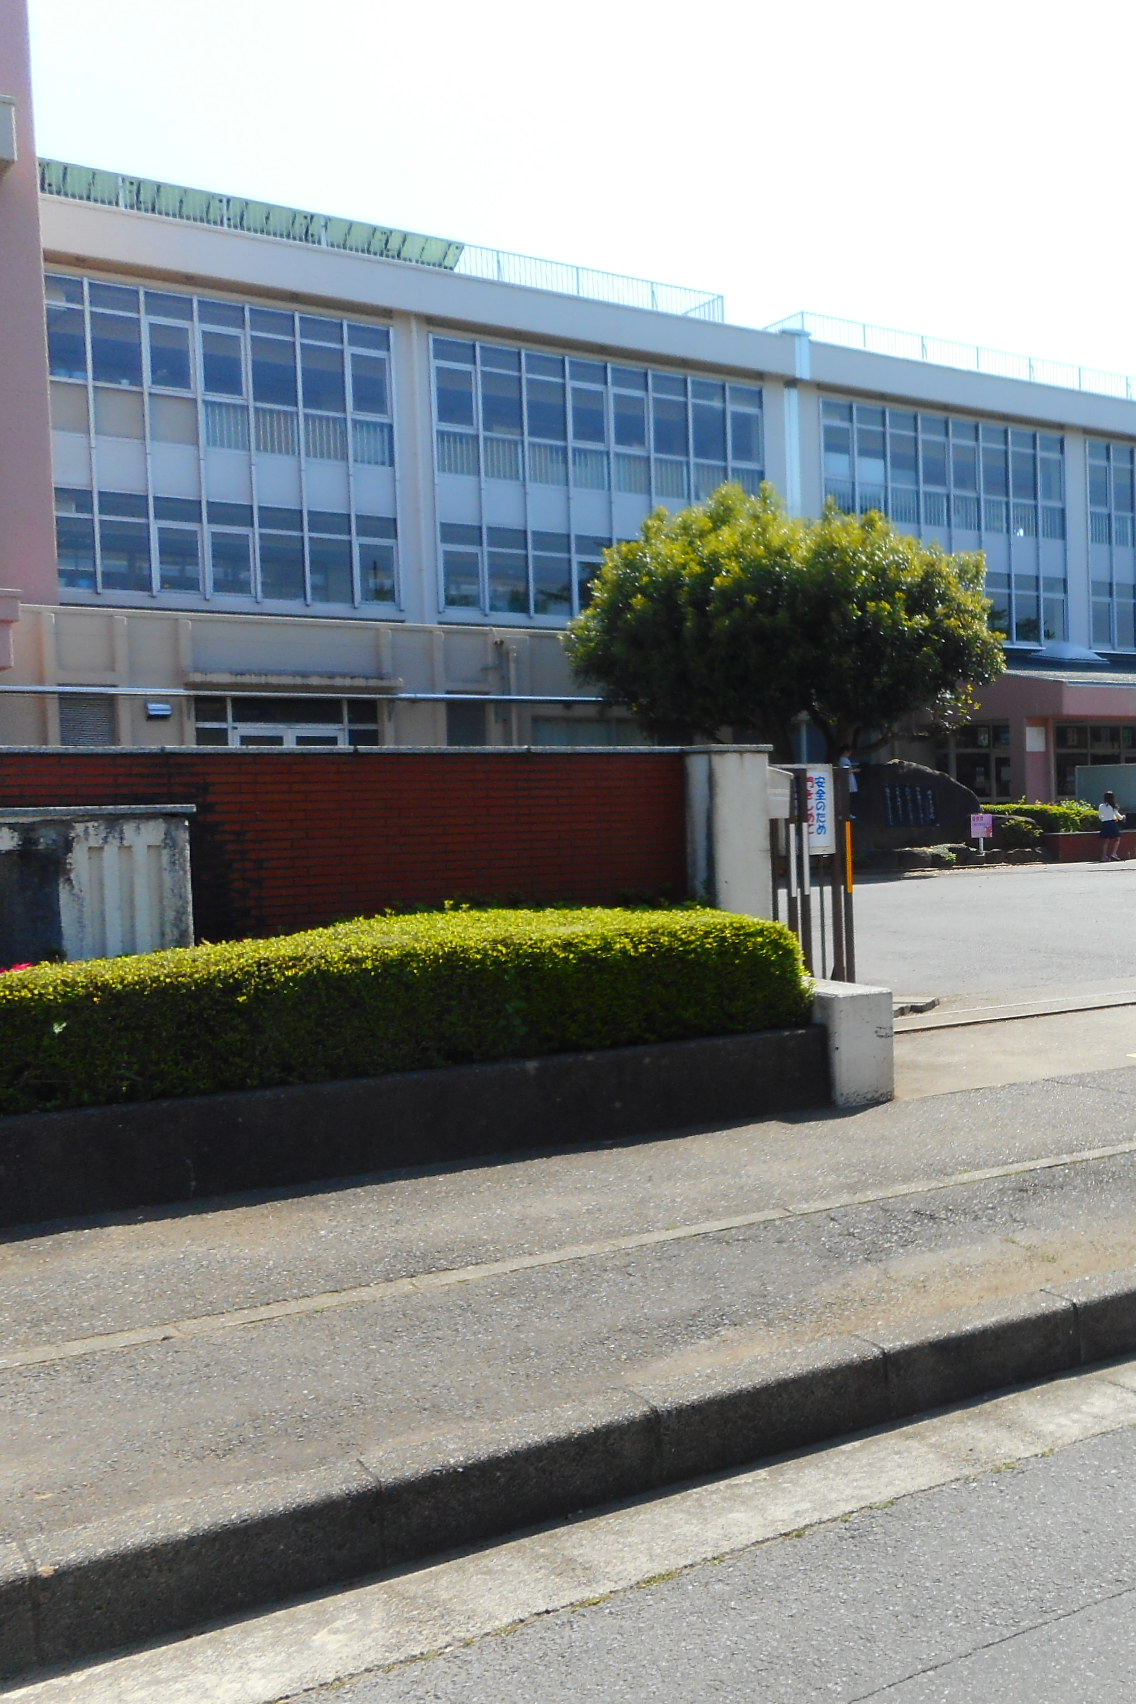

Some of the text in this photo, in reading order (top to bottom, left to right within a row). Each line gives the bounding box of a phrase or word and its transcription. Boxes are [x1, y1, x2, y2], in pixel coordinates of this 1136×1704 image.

[815, 776, 827, 835] 安全のため
